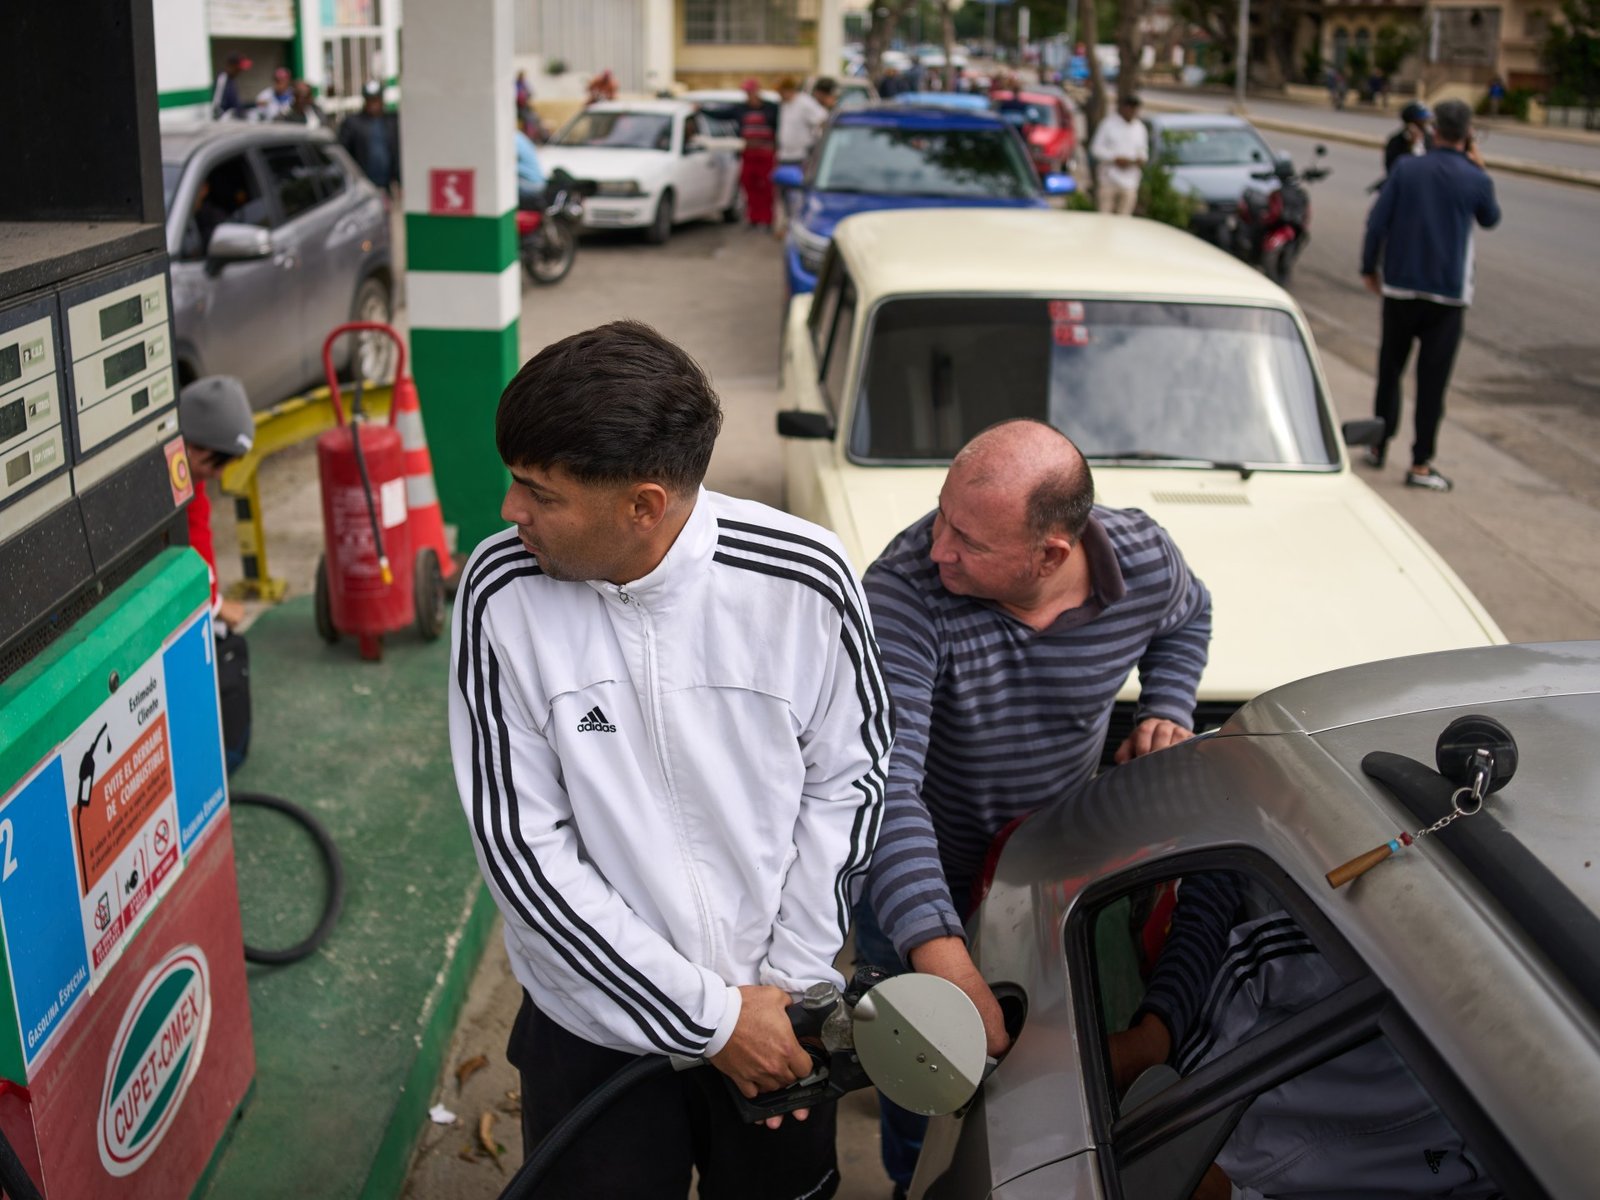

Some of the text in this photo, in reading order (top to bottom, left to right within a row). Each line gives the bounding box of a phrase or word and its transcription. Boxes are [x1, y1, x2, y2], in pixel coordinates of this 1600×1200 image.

[202, 619, 211, 664] 1
[129, 676, 157, 713] Estimado
[137, 699, 158, 726] Cliente
[577, 721, 617, 733] adidas
[104, 768, 124, 802] EVITE
[123, 760, 133, 780] EL
[106, 744, 165, 822] DE COMBUSTIBLE
[0, 818, 18, 882] 2
[28, 964, 87, 1048] GASOLINA ESPECIAL
[115, 988, 199, 1144] CUPET-CIMEX
